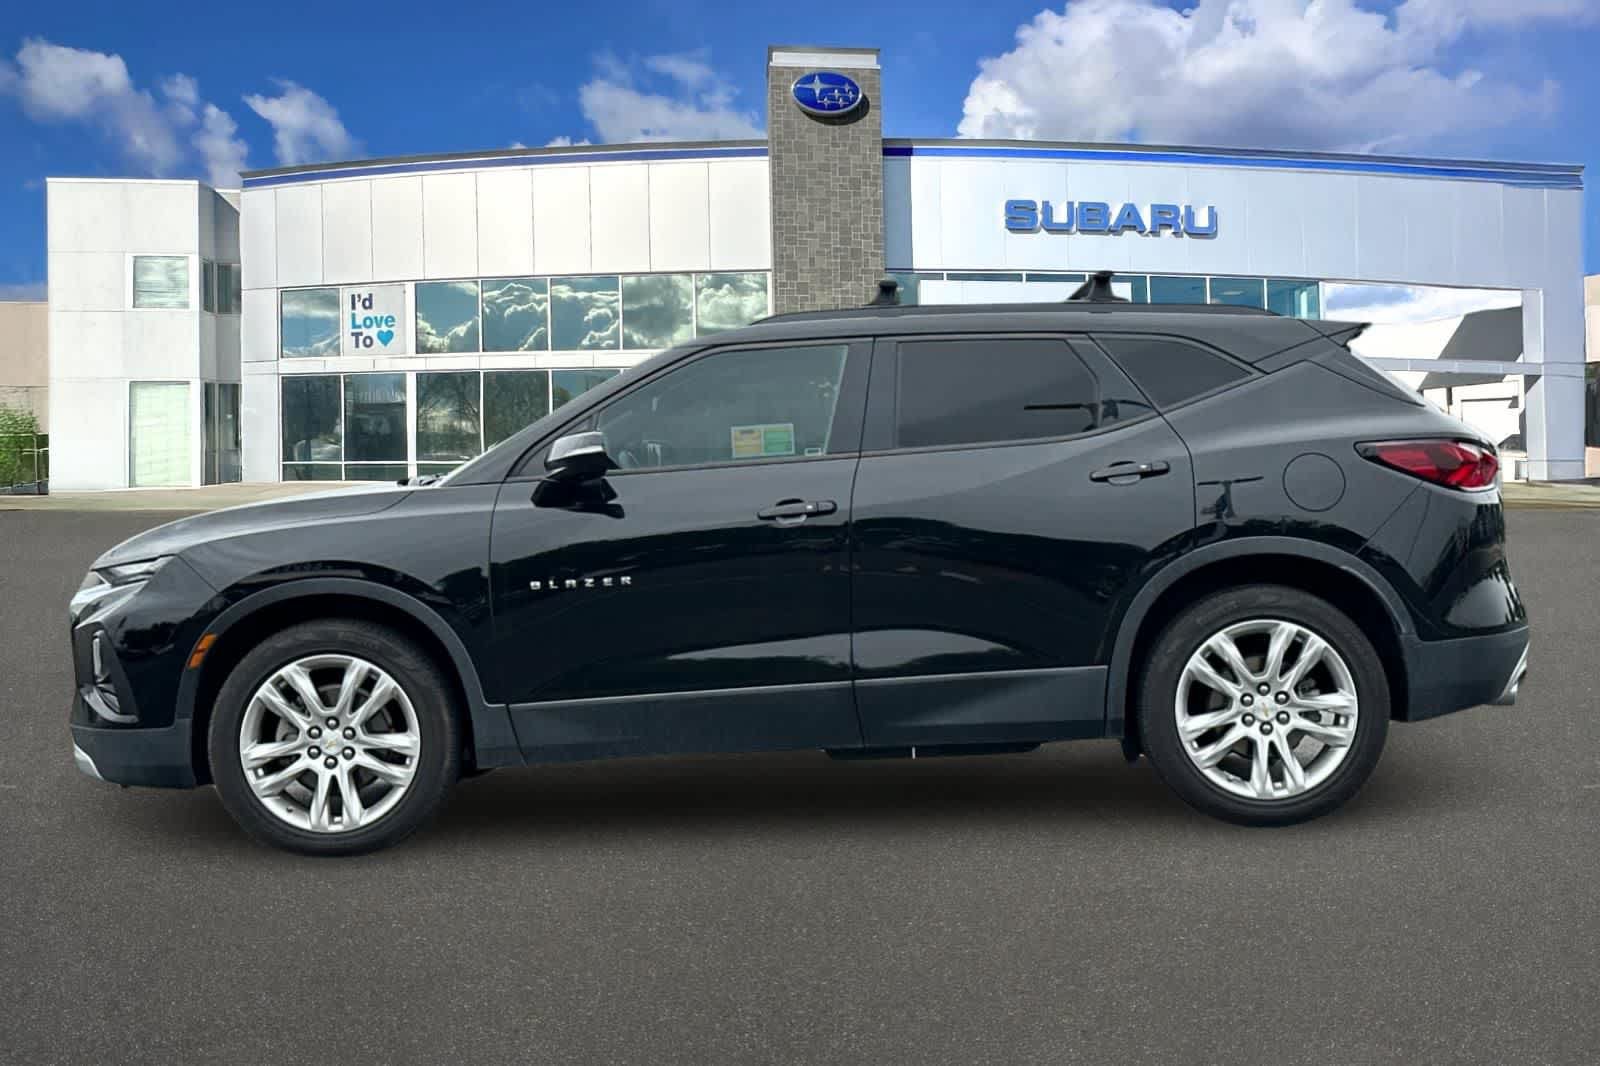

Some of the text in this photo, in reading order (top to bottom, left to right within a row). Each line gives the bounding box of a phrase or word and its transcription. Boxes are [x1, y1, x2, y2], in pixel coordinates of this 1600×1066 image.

[1005, 199, 1217, 237] SUBARU
[351, 293, 373, 310] I'd
[351, 312, 396, 329] Love
[351, 331, 374, 348] To
[529, 576, 631, 590] BLAZER
